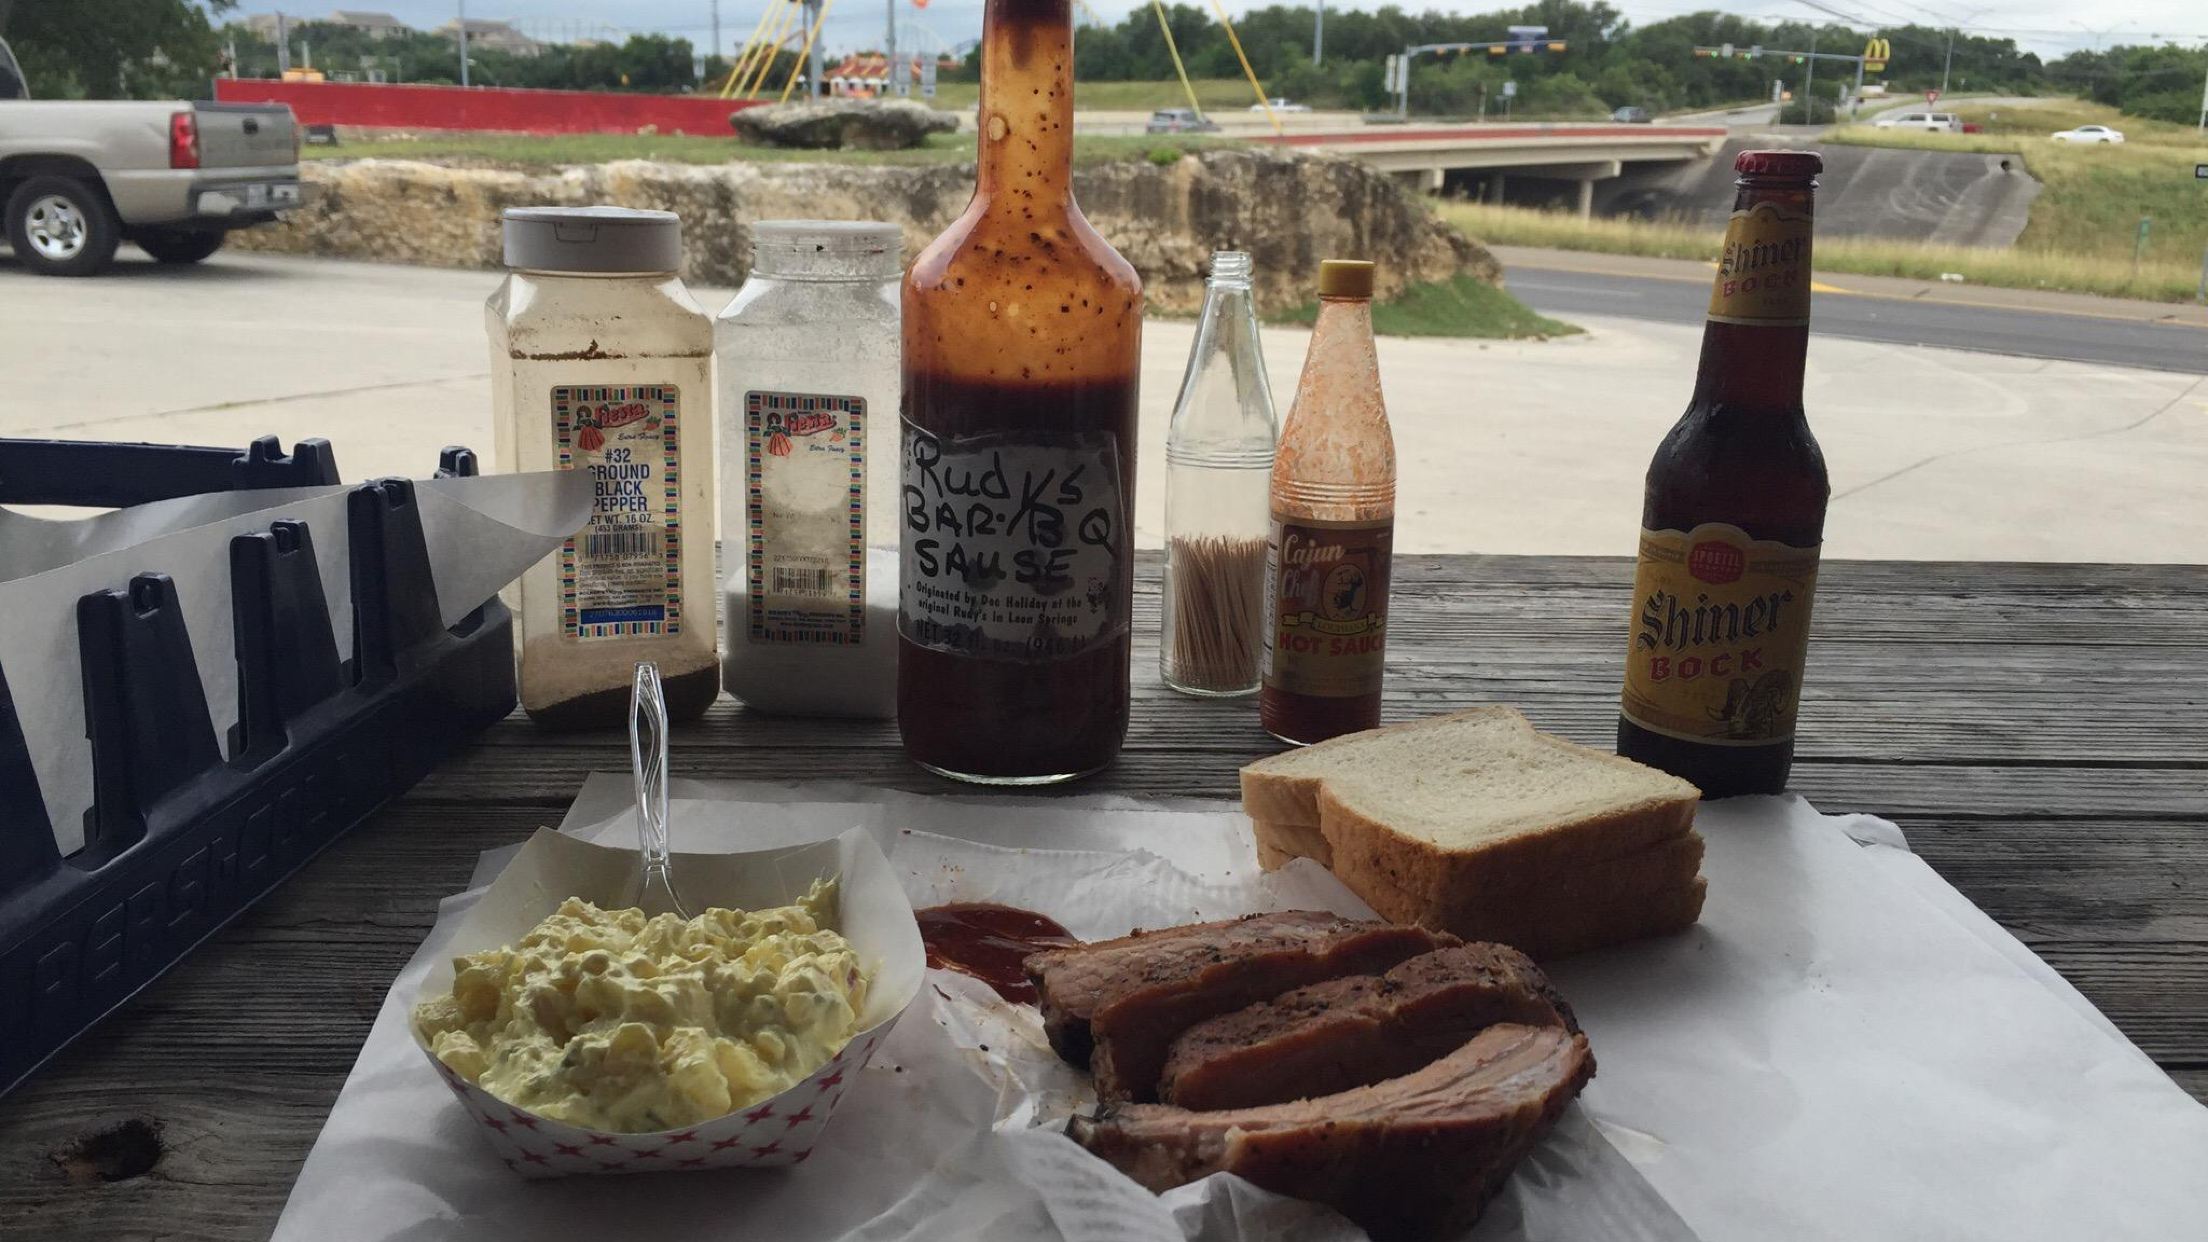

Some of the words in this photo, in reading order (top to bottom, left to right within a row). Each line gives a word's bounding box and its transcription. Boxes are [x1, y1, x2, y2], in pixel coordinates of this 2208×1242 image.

[605, 447, 631, 464] #32
[595, 481, 643, 496] BLACK
[588, 514, 602, 525] ET
[604, 514, 622, 525] WT.
[626, 514, 636, 524] 16
[639, 513, 655, 523] OZ.
[914, 539, 1079, 584] SAUSE
[1283, 534, 1345, 570] Cajun
[916, 581, 961, 603] Originated
[964, 590, 977, 607] by
[981, 594, 1000, 607] Doc
[1006, 596, 1048, 611] Holiday
[1052, 598, 1063, 609] at
[1066, 597, 1082, 609] the
[918, 599, 950, 618] original
[1009, 612, 1034, 625] Leon
[1637, 589, 1795, 651] Shiner
[1279, 632, 1323, 655] HOT
[1650, 647, 1765, 682] BOCK
